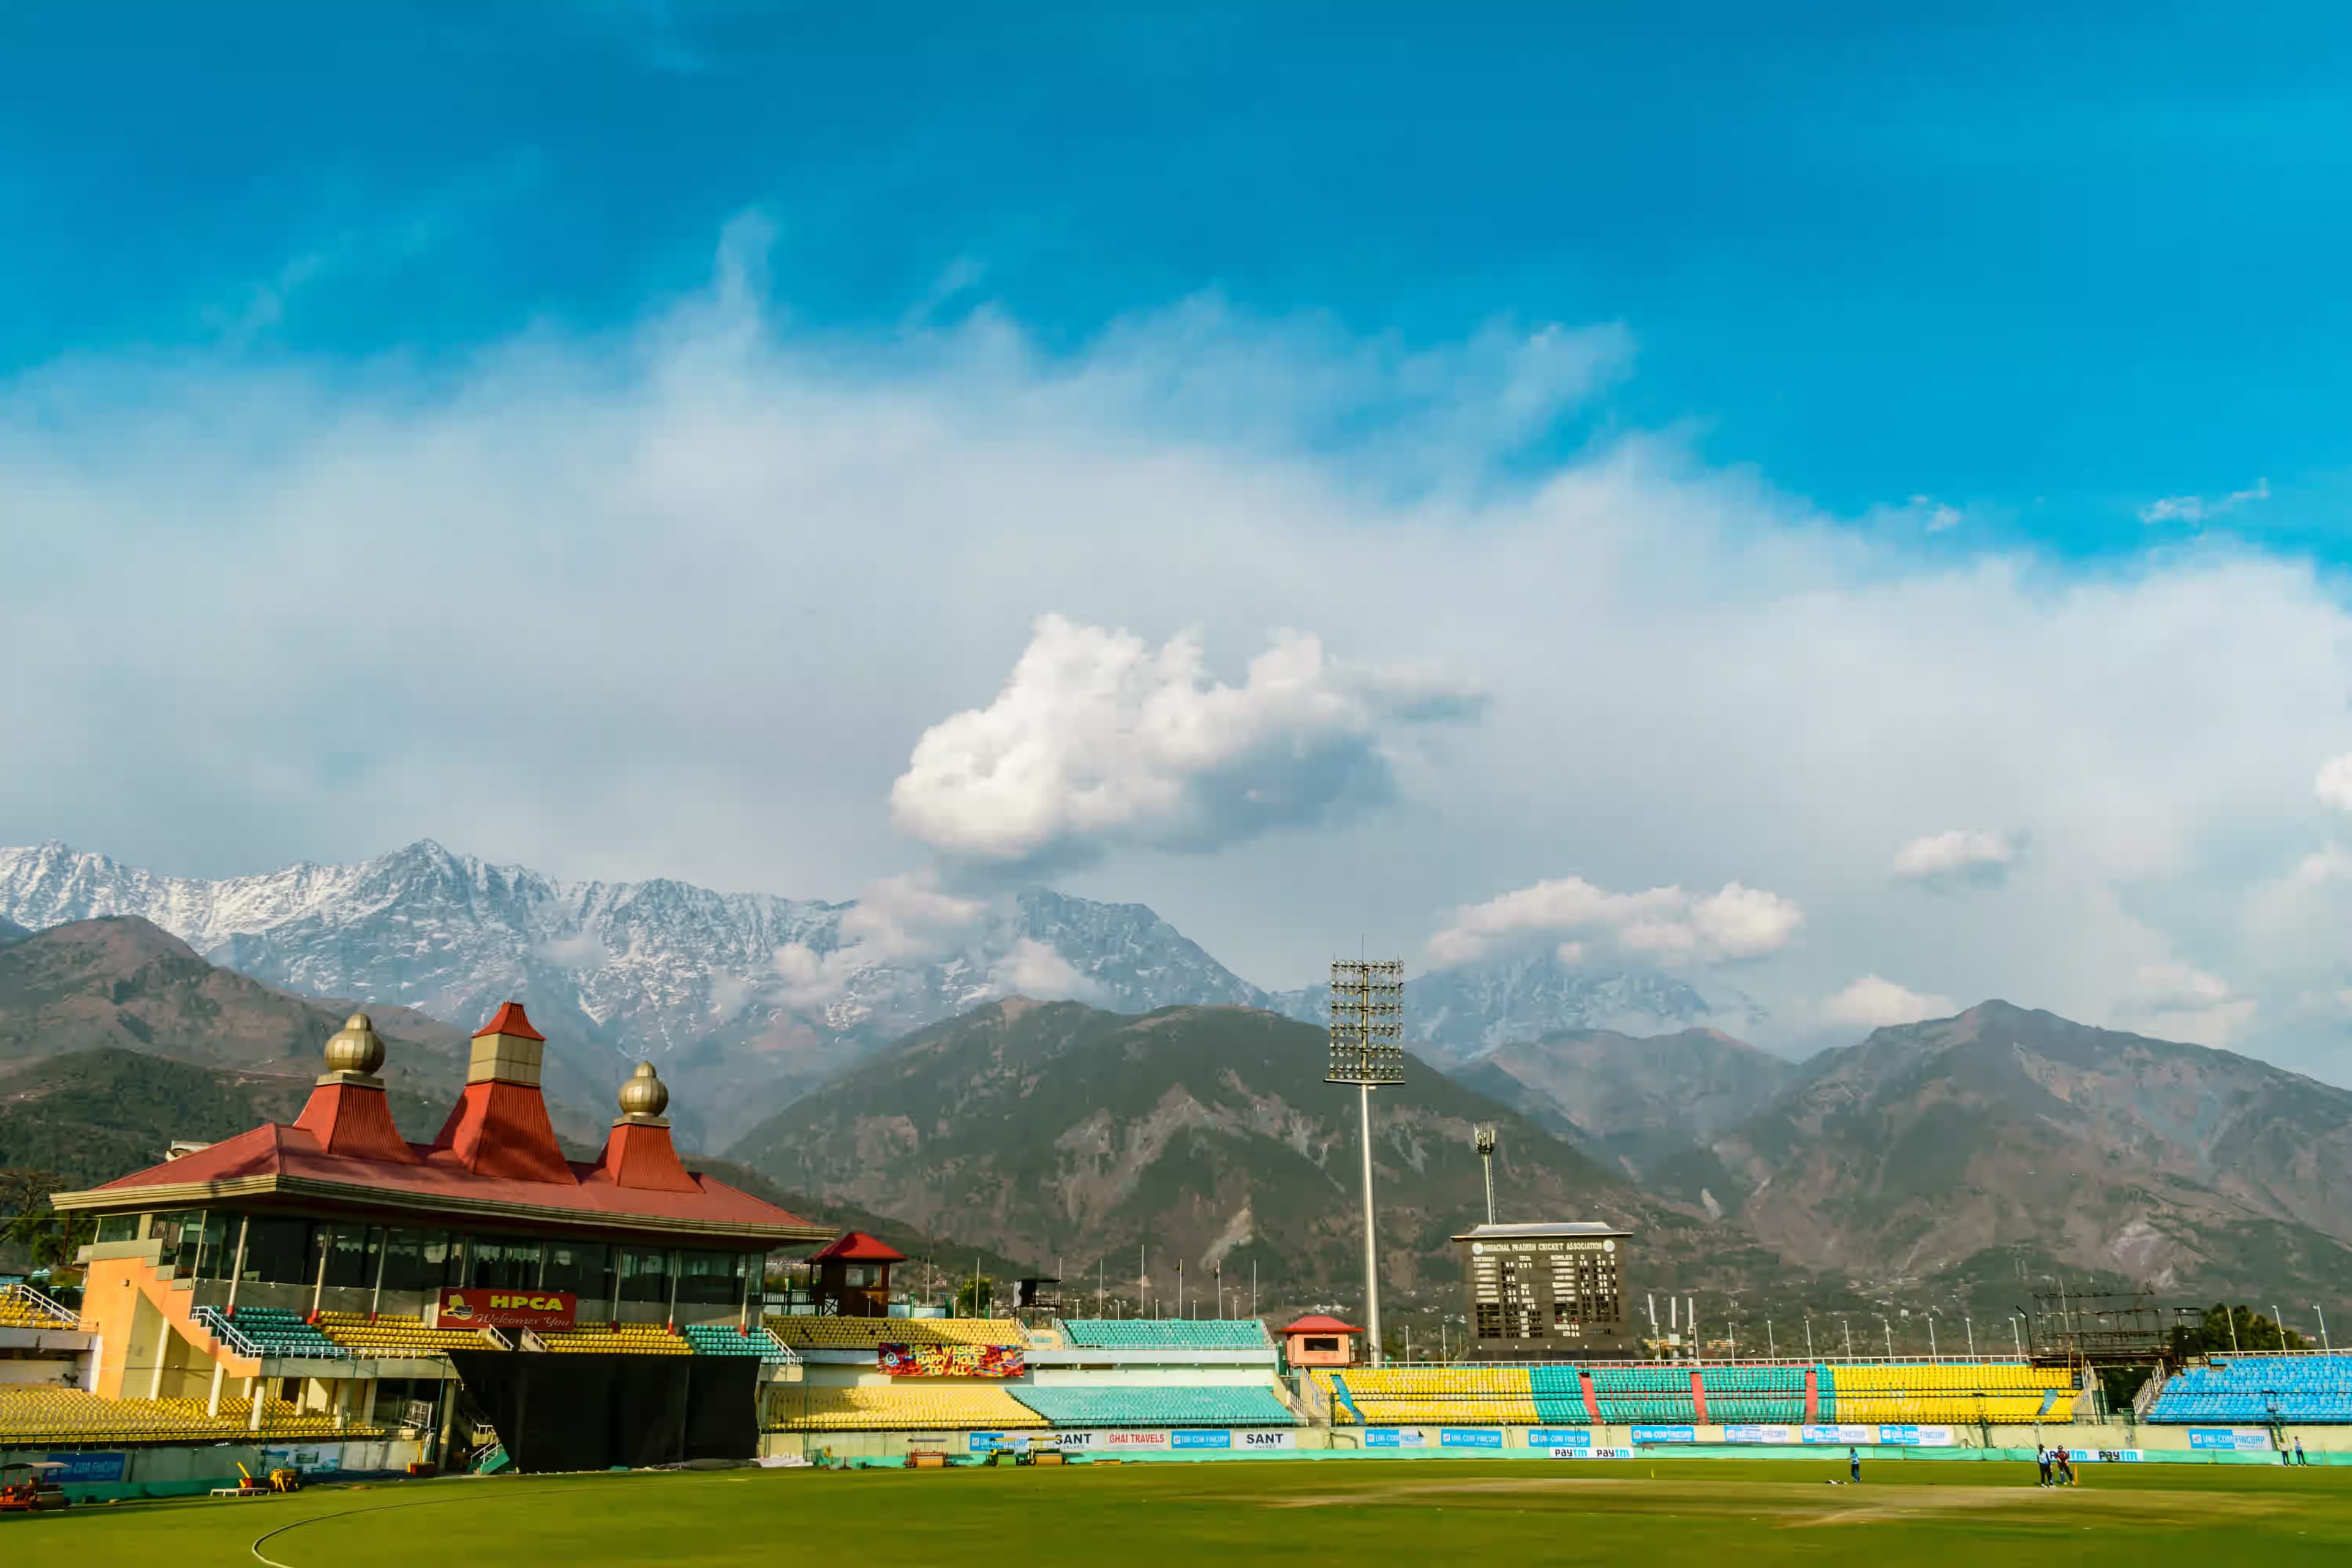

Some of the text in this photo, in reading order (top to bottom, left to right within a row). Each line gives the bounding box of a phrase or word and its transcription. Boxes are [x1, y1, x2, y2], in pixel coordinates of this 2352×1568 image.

[491, 1295, 564, 1311] HPCA
[475, 1313, 570, 1327] Welcomes You
[910, 1345, 987, 1355] HPCA WISHES
[916, 1355, 981, 1365] HAPPY HOLI
[929, 1366, 968, 1375] TO ALL
[1055, 1434, 1092, 1445] SANT
[1109, 1434, 1164, 1443] GHAI TRAVELS
[1246, 1434, 1283, 1444] SANT
[2203, 1434, 2234, 1444] UNI-COM
[2049, 1450, 2087, 1460] Pytm
